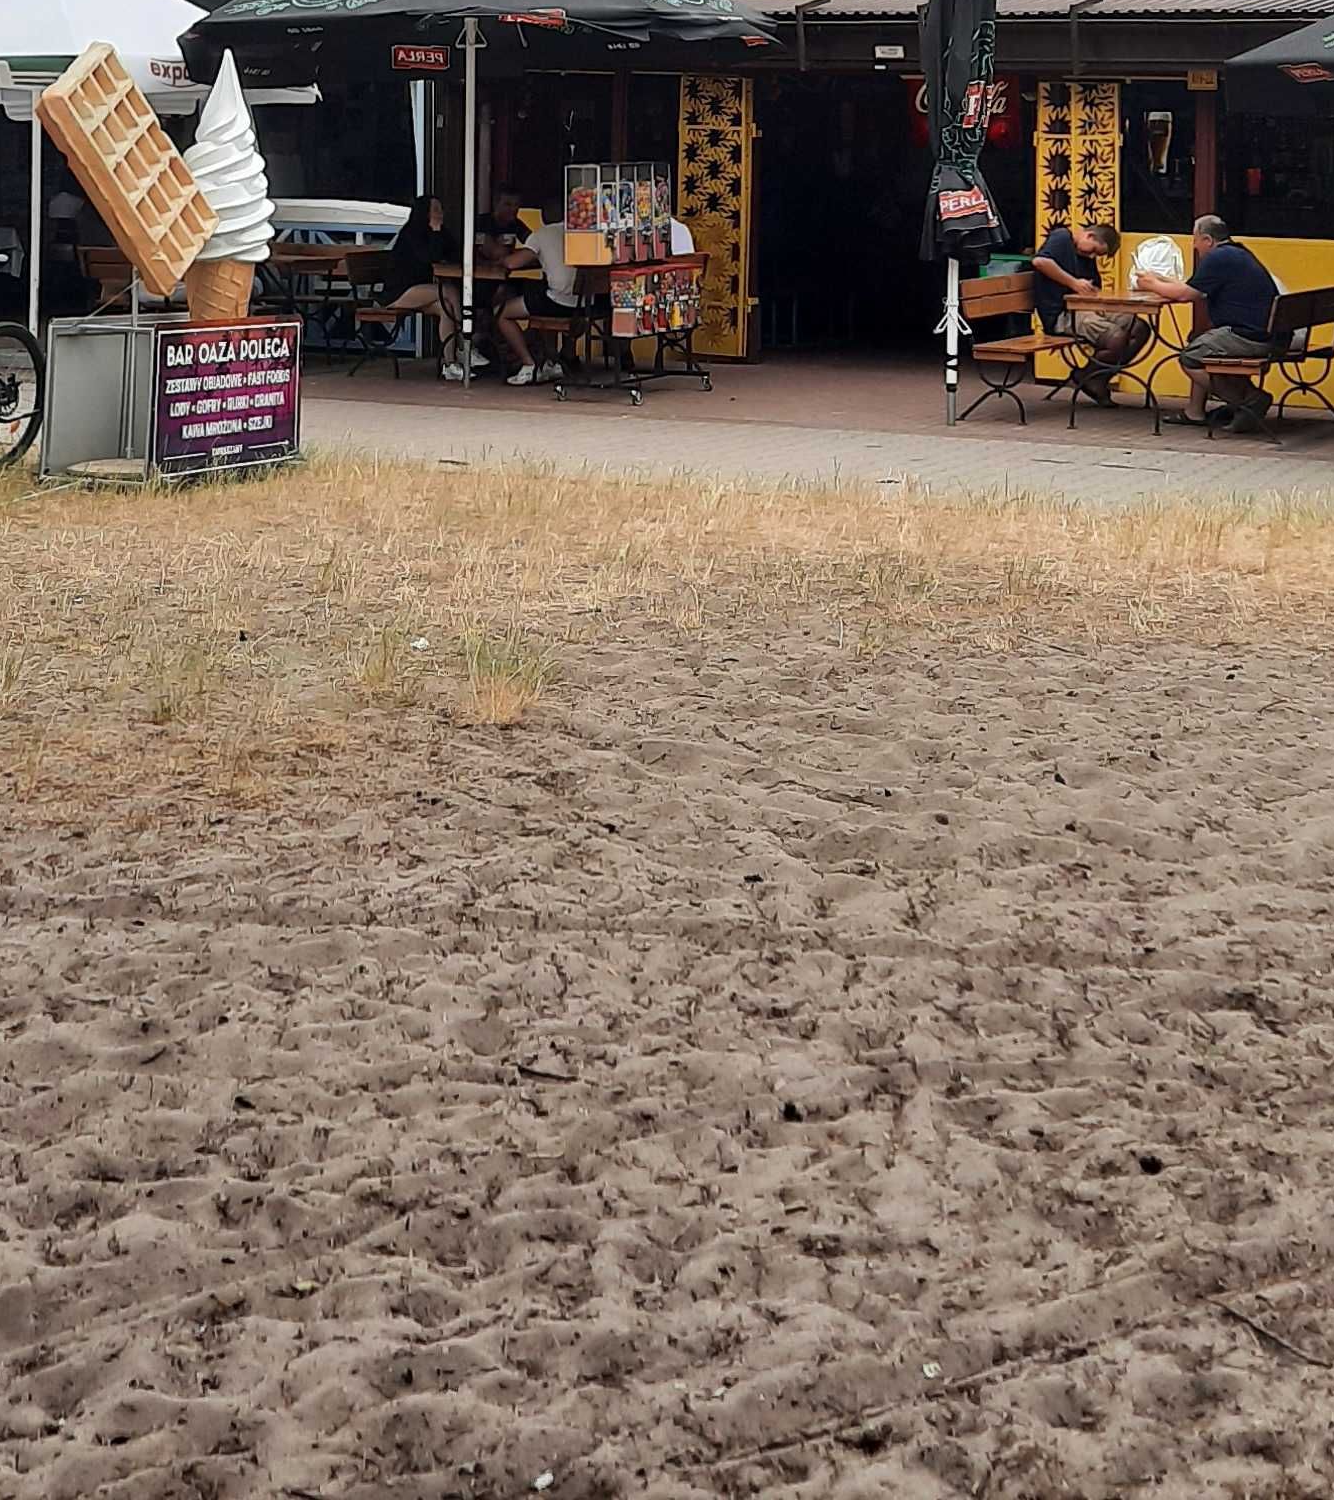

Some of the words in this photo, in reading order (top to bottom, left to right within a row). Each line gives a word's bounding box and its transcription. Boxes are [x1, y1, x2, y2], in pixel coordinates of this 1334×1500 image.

[166, 344, 194, 367] BAR
[198, 341, 237, 364] OAZA
[239, 337, 291, 361] POLECA
[165, 377, 203, 394] ZESTAWY
[203, 373, 243, 390] OBIADOWE
[247, 371, 266, 386] FAST
[266, 369, 291, 384] FOODS
[169, 401, 191, 417] LODY
[196, 398, 222, 414] GOFRY
